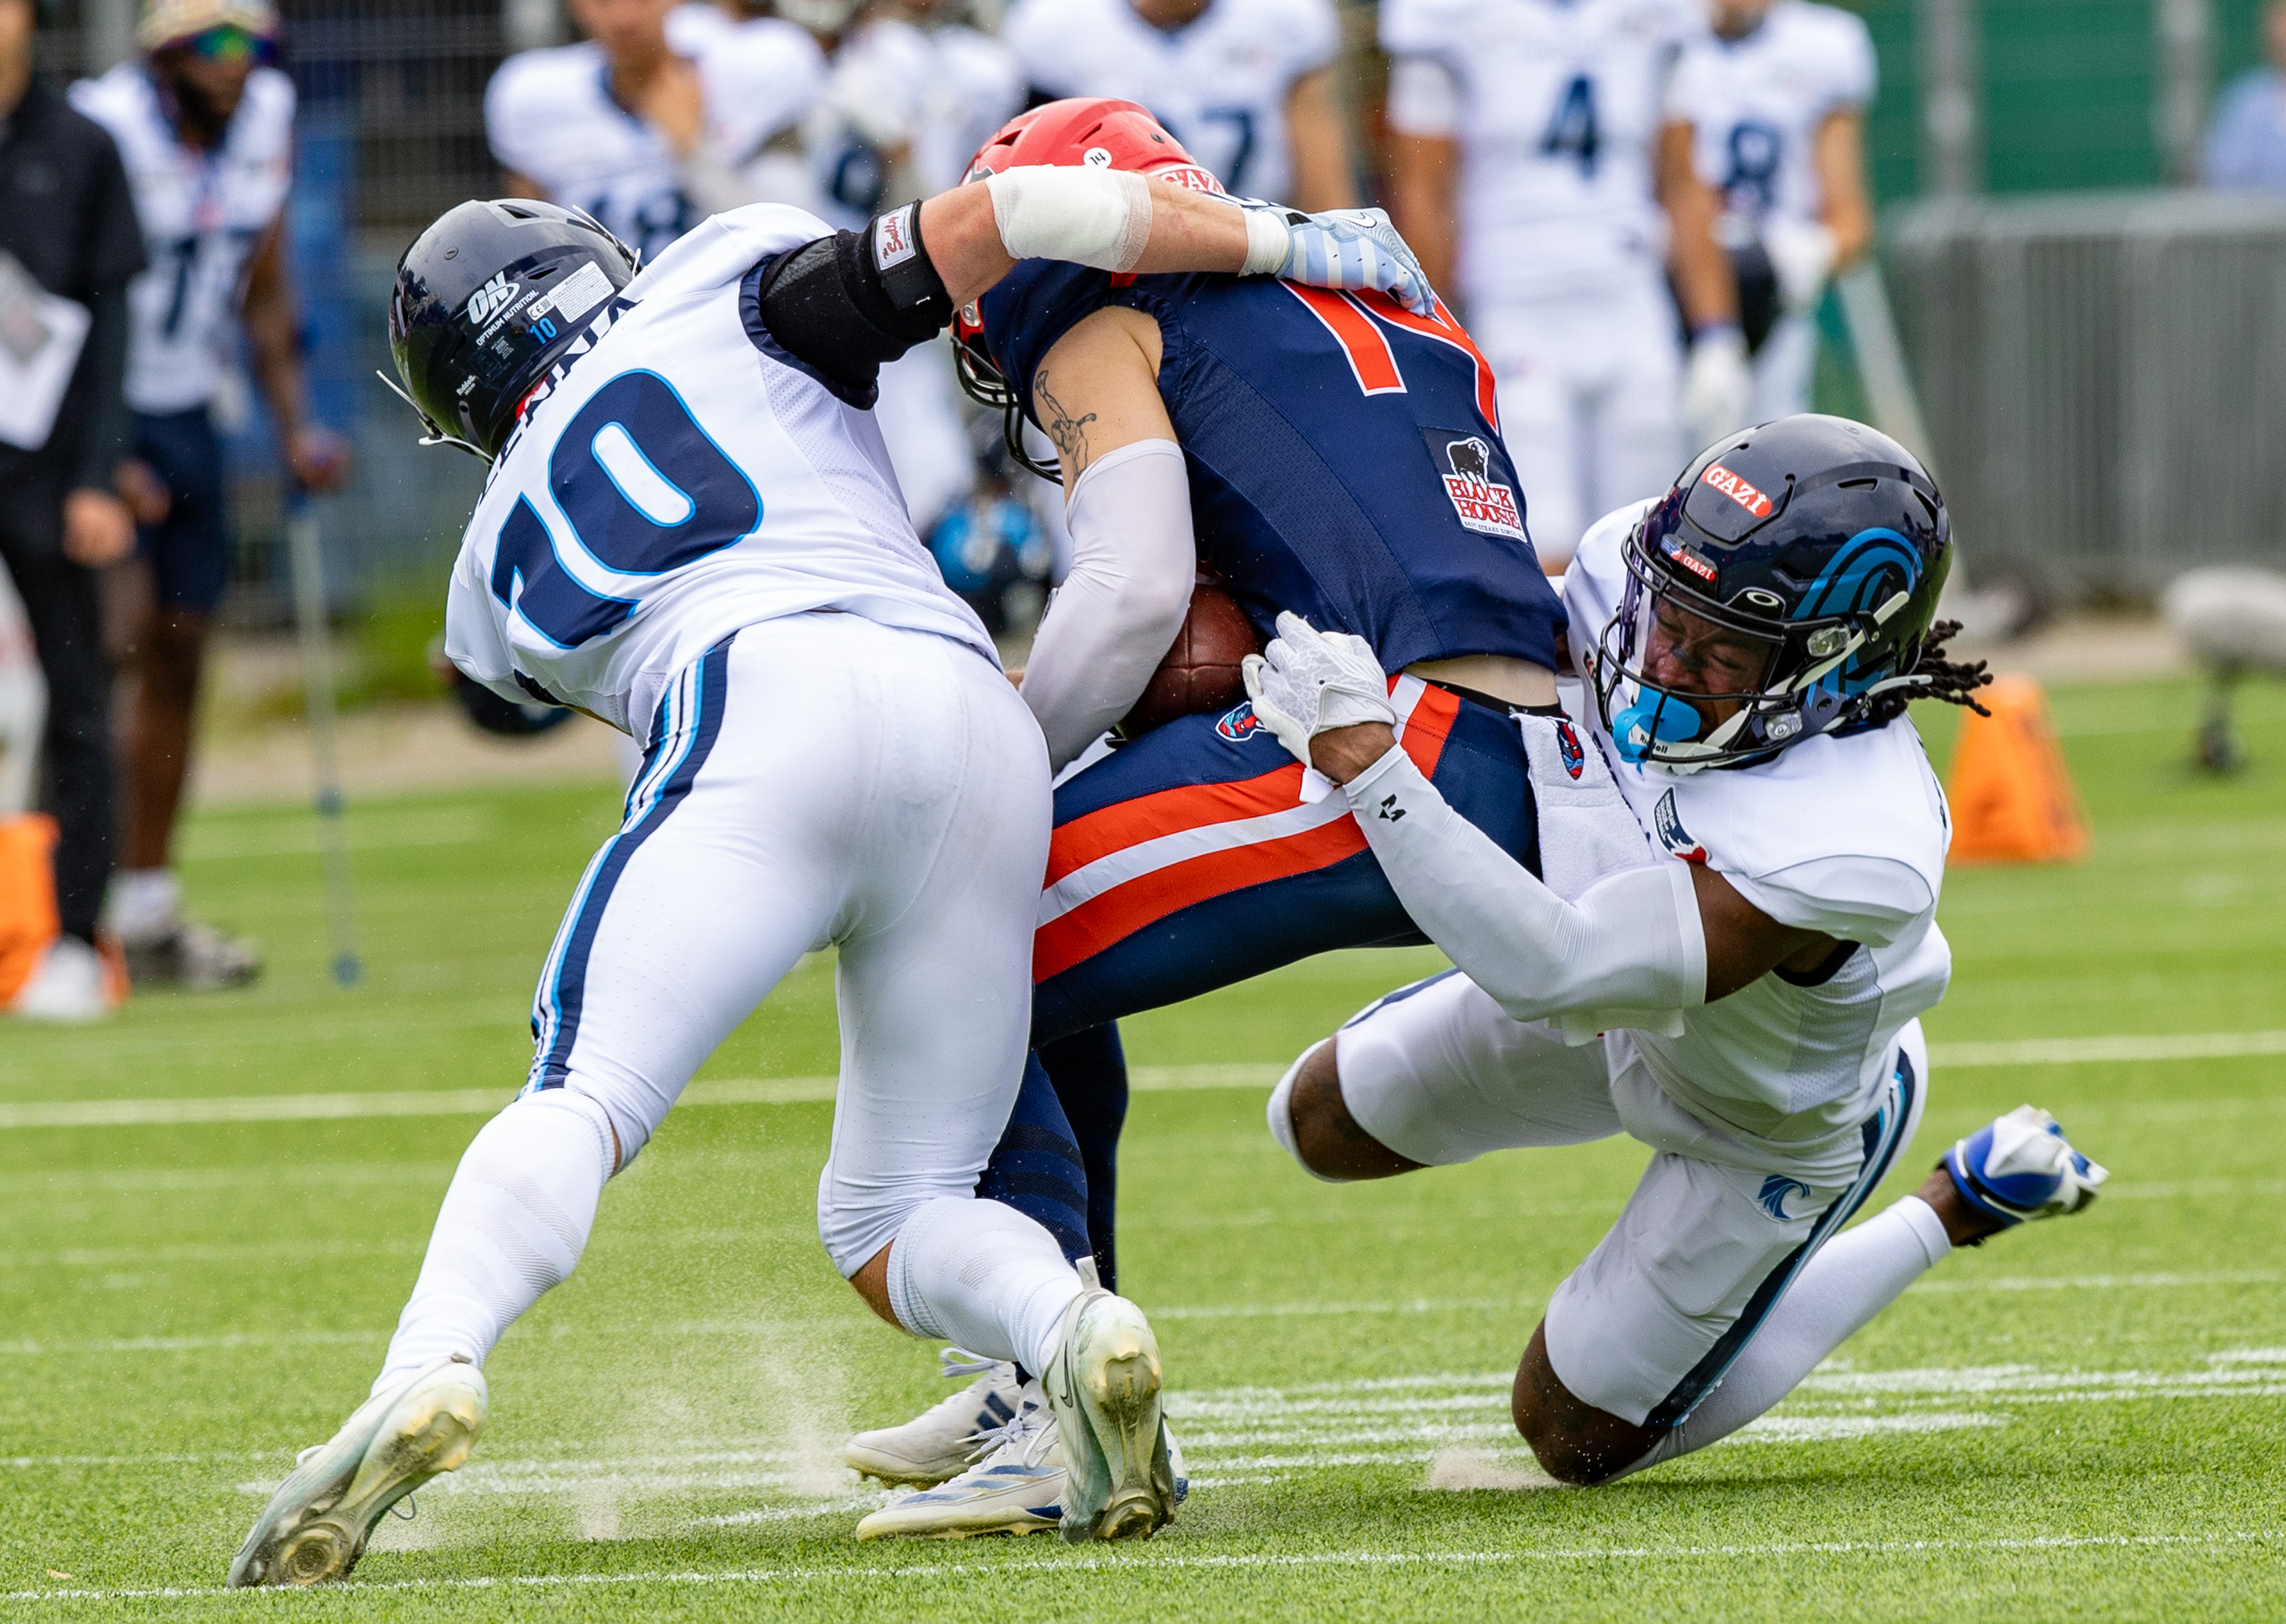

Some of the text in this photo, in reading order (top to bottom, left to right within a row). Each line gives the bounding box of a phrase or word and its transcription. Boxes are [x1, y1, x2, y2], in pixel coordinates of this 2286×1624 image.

[1538, 75, 1601, 184] 4
[1089, 151, 1106, 166] 14
[1160, 169, 1227, 193] GAZ
[467, 271, 510, 324] ON
[476, 316, 507, 347] OPTIMUM
[529, 317, 558, 345] 10
[491, 368, 763, 649] 10
[1445, 477, 1514, 510] BLOCK
[1454, 498, 1523, 531] HOUSE
